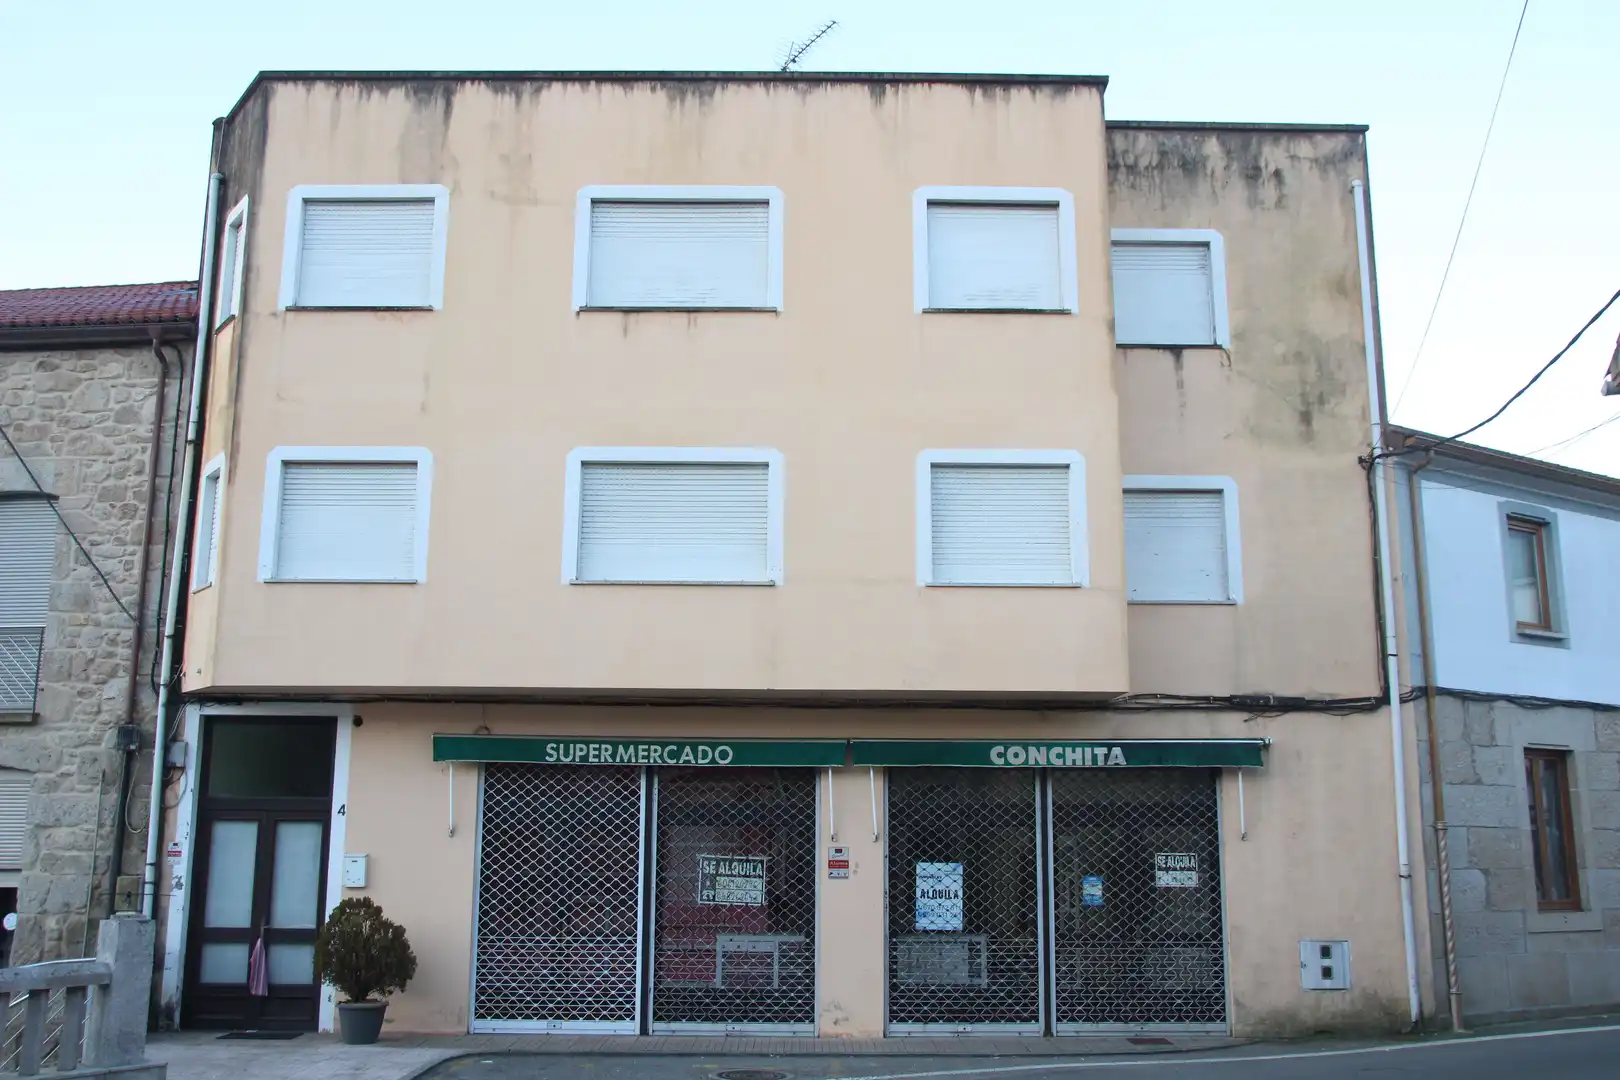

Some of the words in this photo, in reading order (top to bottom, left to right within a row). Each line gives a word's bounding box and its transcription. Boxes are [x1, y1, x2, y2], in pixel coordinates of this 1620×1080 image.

[545, 743, 733, 765] SUPERMERCADO
[989, 745, 1127, 767] CONCHITA
[337, 803, 346, 816] 4
[703, 860, 717, 874] SE
[718, 861, 763, 876] ALQUILA
[920, 888, 959, 899] ALQUILA
